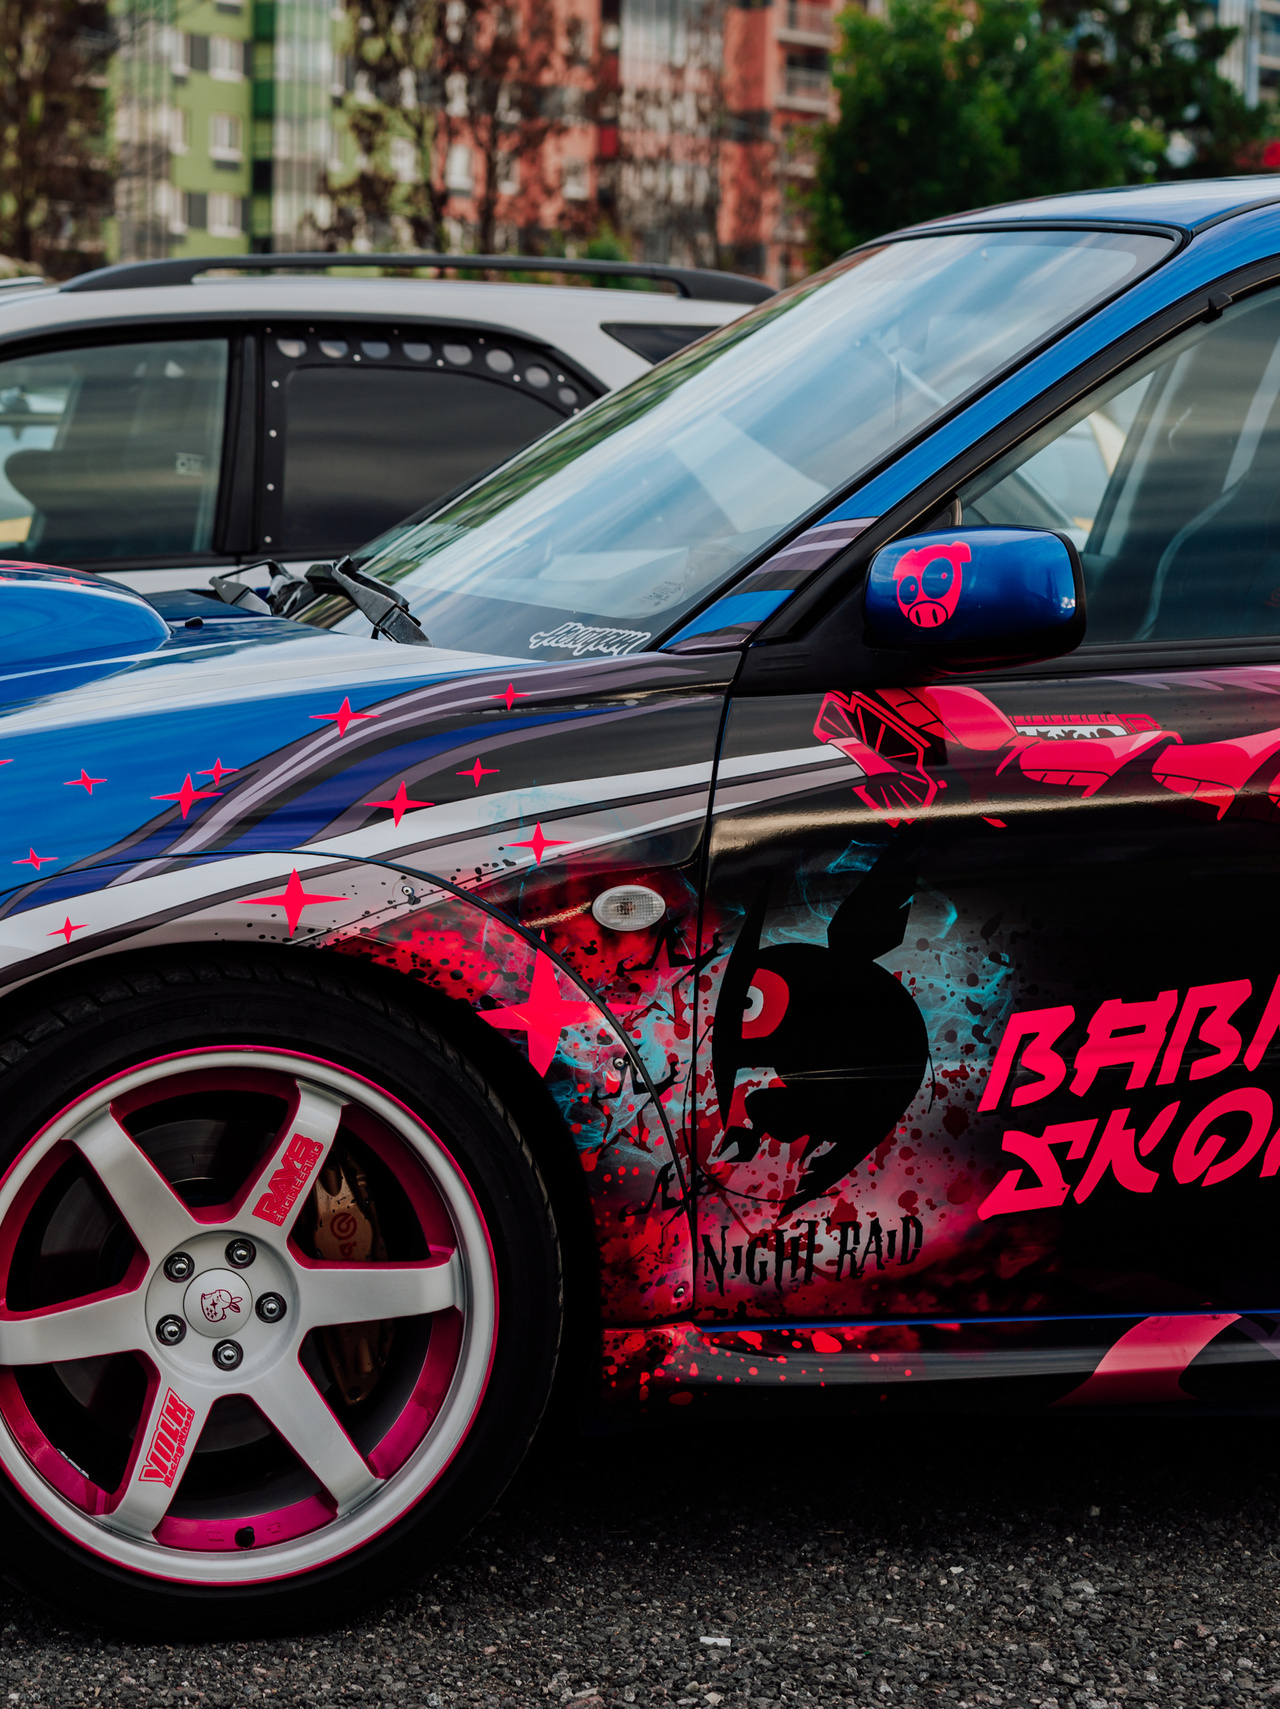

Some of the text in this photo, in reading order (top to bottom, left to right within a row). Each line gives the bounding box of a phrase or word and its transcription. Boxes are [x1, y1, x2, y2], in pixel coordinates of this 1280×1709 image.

[252, 1133, 314, 1225] RAYS
[274, 1141, 324, 1227] ENGINEERING
[977, 1086, 1280, 1221] SKO
[140, 1389, 188, 1480] VOLK
